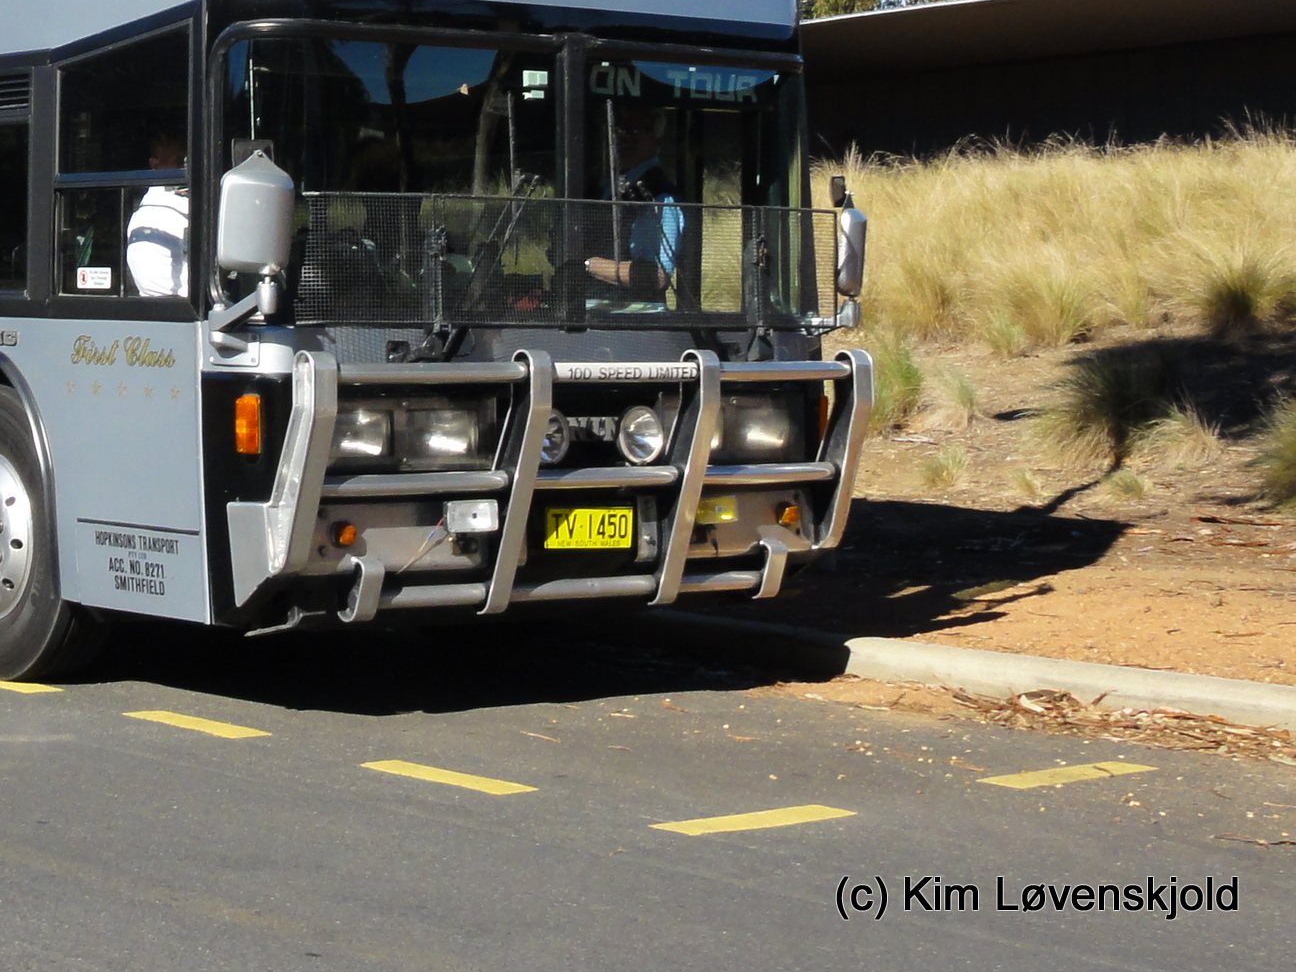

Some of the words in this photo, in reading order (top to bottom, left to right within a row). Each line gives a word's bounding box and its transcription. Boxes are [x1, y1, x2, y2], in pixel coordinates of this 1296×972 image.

[589, 64, 642, 97] ON
[667, 70, 758, 103] TOUR
[70, 335, 120, 366] First
[122, 336, 177, 369] Class
[567, 366, 592, 381] 100
[598, 366, 643, 381] SPEED
[648, 366, 699, 380] LIMITED
[94, 530, 137, 550] HOPKINSONS
[138, 535, 179, 555] TRANSPORT
[574, 539, 597, 547] SOUTH
[108, 556, 128, 574] ACC.
[114, 575, 166, 596] SMITHFIELD
